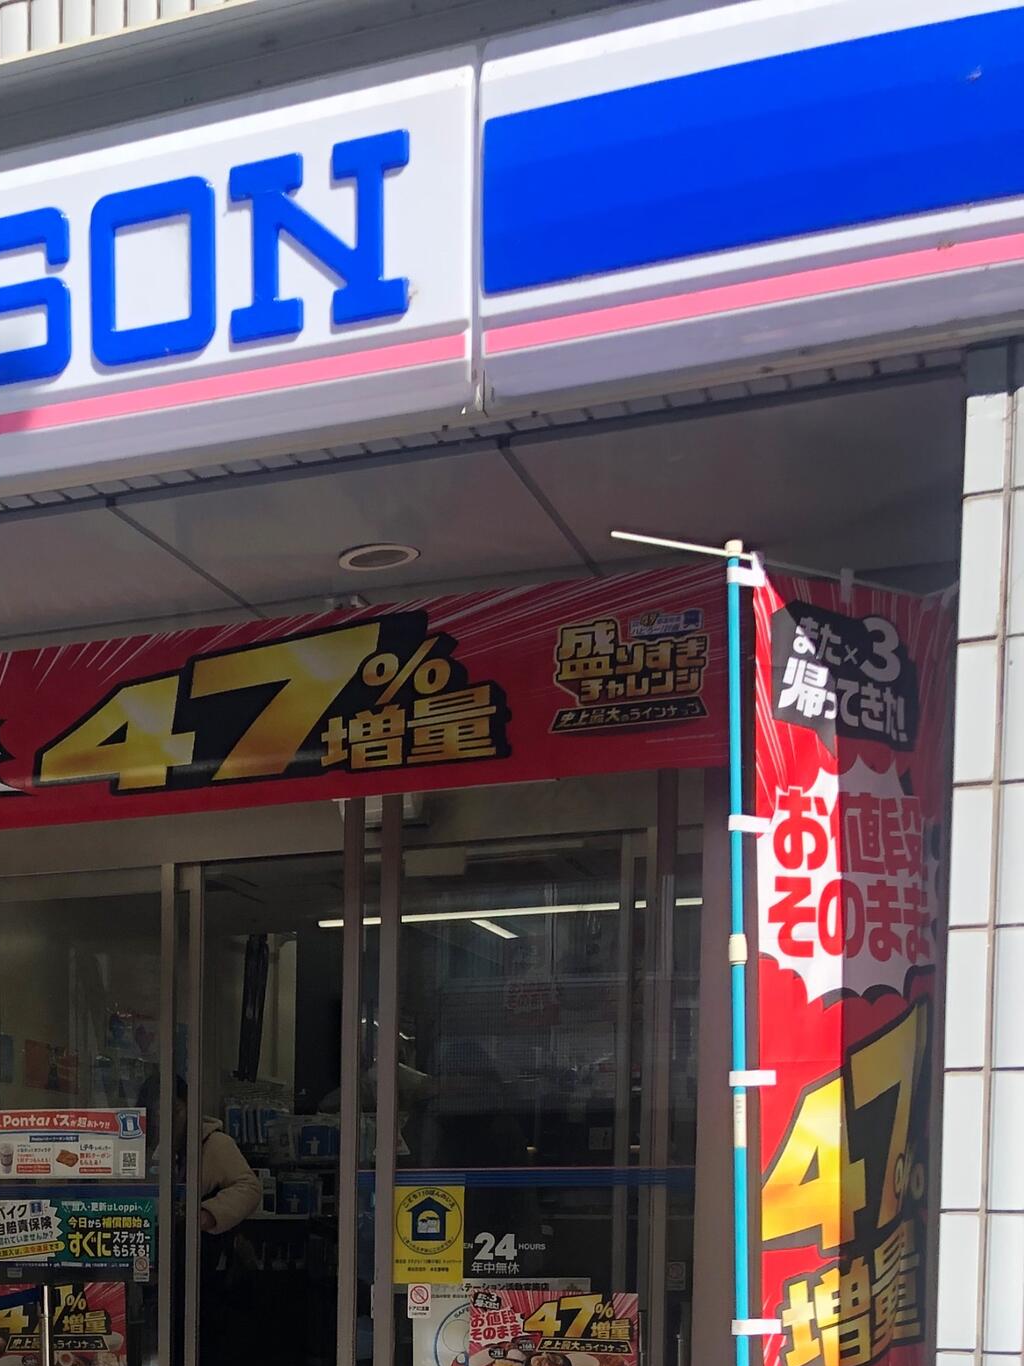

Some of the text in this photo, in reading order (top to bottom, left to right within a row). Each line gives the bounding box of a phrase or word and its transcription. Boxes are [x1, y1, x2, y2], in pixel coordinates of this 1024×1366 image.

[556, 619, 709, 682] 盛りすぎ
[578, 668, 701, 704] チャレンジ
[777, 656, 908, 742] 帰ってきた!
[39, 621, 452, 790] 47%
[319, 684, 498, 771] 増量
[761, 1004, 926, 1250] 47%
[67, 1230, 112, 1257] すぐに
[112, 1231, 151, 1243] ステッカー
[112, 1244, 150, 1257] もらえる!
[473, 1231, 518, 1261] 24
[518, 1242, 547, 1250] HOURS
[471, 1261, 520, 1275] 年中無休
[61, 1310, 107, 1334] 増量
[471, 1310, 517, 1328] お値段
[523, 1294, 615, 1338] 47%
[590, 1318, 632, 1340] 増量
[470, 1325, 523, 1341] そのまま
